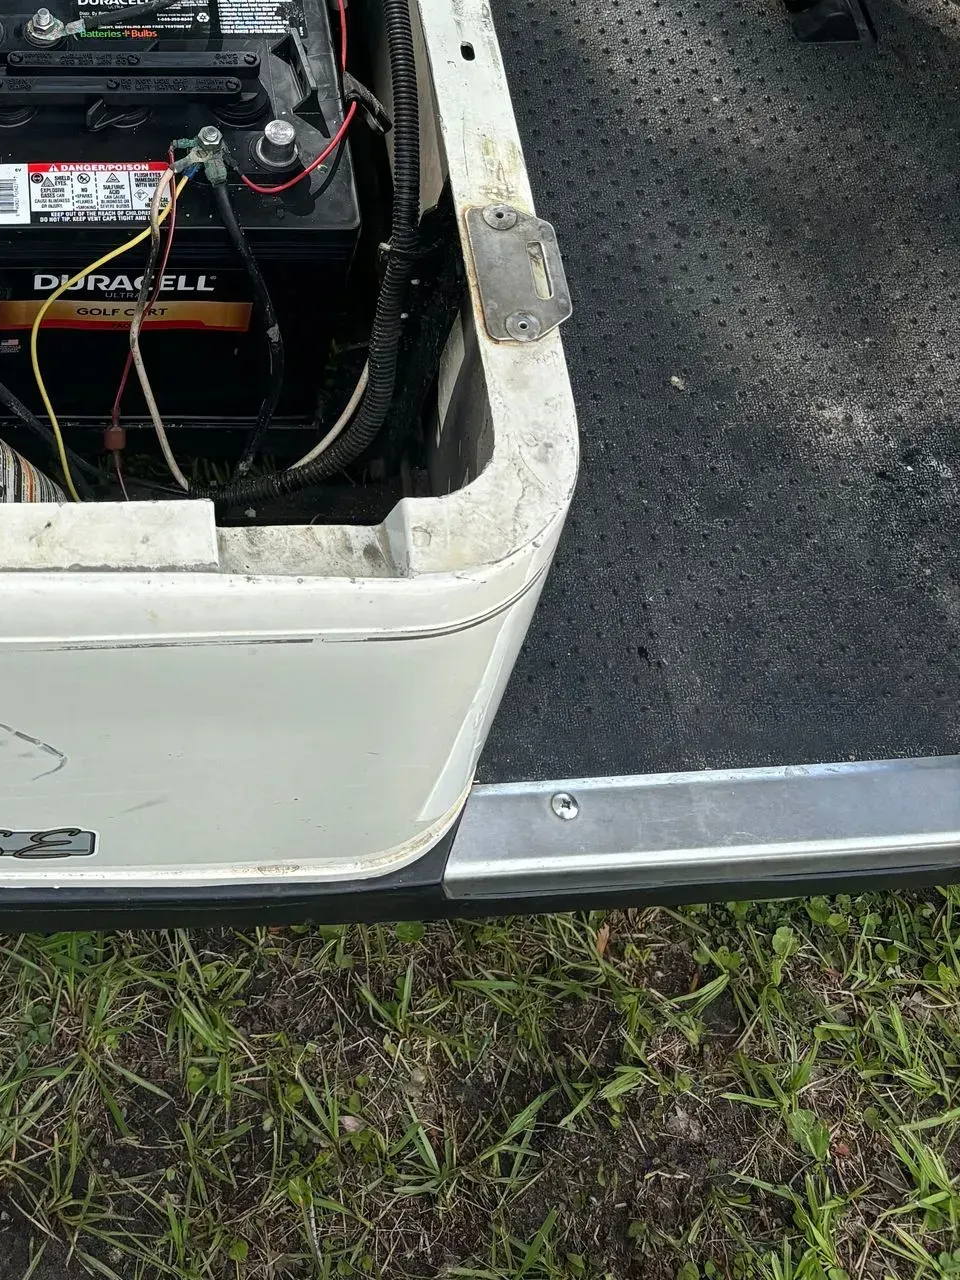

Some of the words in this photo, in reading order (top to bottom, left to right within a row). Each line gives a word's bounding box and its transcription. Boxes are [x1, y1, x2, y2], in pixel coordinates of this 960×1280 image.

[60, 163, 149, 171] DANGER/POISON
[33, 274, 215, 292] DURACELL
[76, 308, 119, 316] GOLF
[123, 308, 168, 316] CRT
